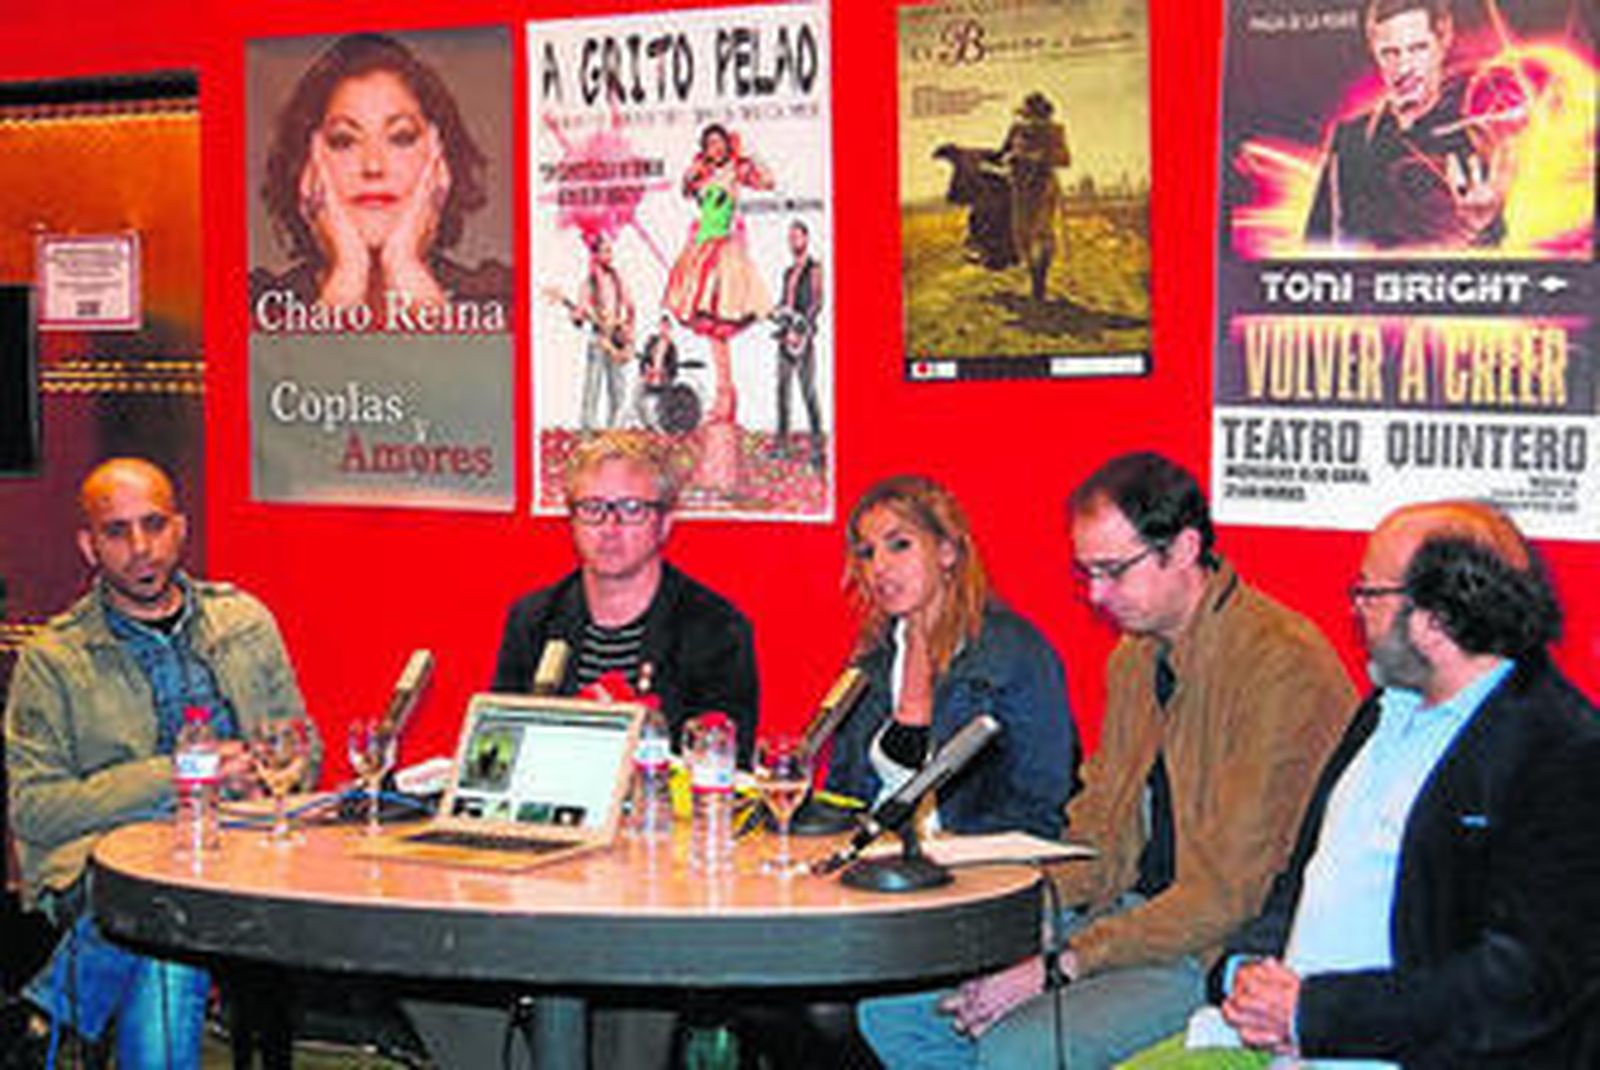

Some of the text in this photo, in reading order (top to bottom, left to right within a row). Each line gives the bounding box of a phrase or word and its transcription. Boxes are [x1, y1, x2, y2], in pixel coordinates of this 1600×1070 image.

[543, 24, 818, 105] A GRITO PELAO
[256, 291, 506, 332] Charo Reina
[1244, 318, 1567, 406] VOLVER A CREER
[270, 381, 403, 431] Coplas
[340, 433, 493, 478] Amores
[1221, 418, 1587, 474] TEATRO QUINTERO
